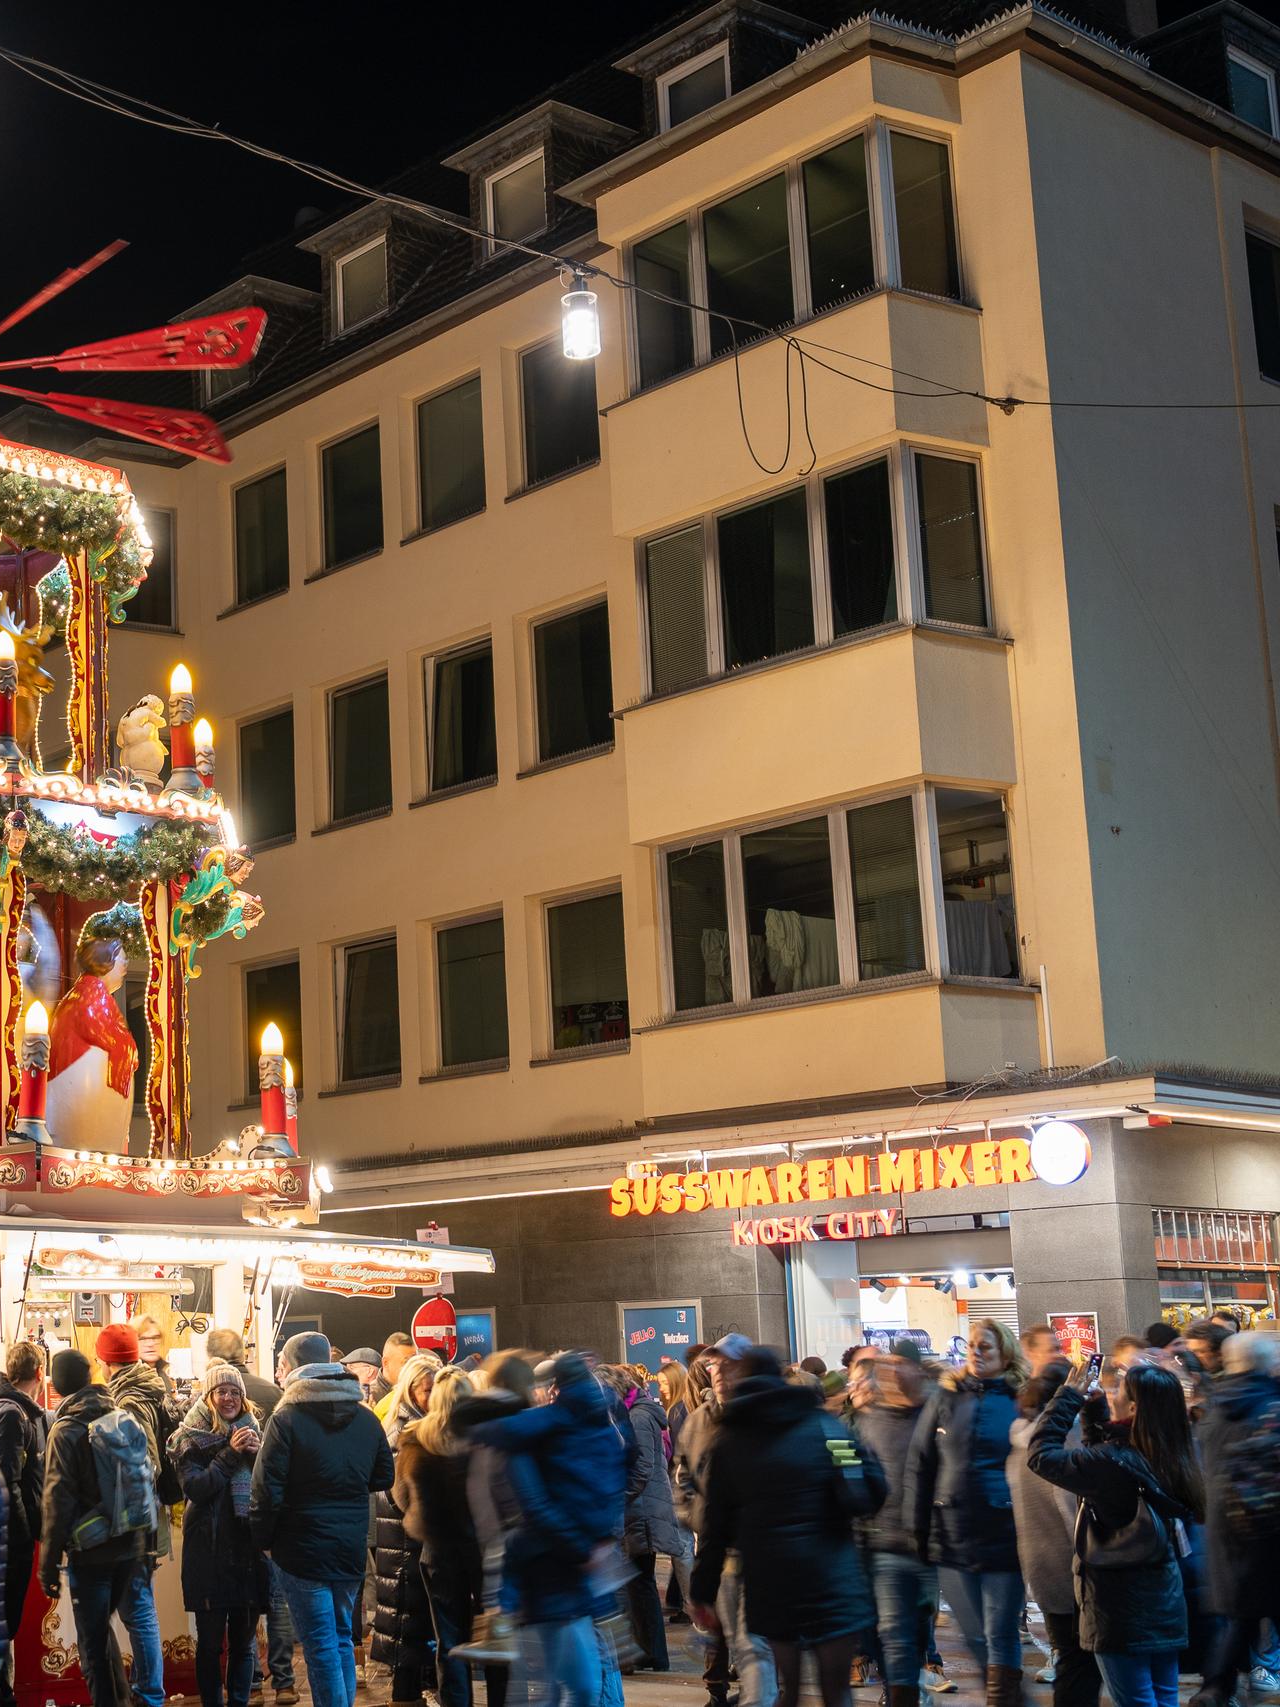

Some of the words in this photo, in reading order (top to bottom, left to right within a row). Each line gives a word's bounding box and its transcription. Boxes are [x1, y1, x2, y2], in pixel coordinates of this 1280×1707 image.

[610, 1155, 868, 1217] SÜSSWAREN
[878, 1137, 1036, 1195] MIXER
[732, 1215, 816, 1246] KIOSK
[827, 1207, 897, 1240] CITY
[1055, 1328, 1093, 1341] RAMEN
